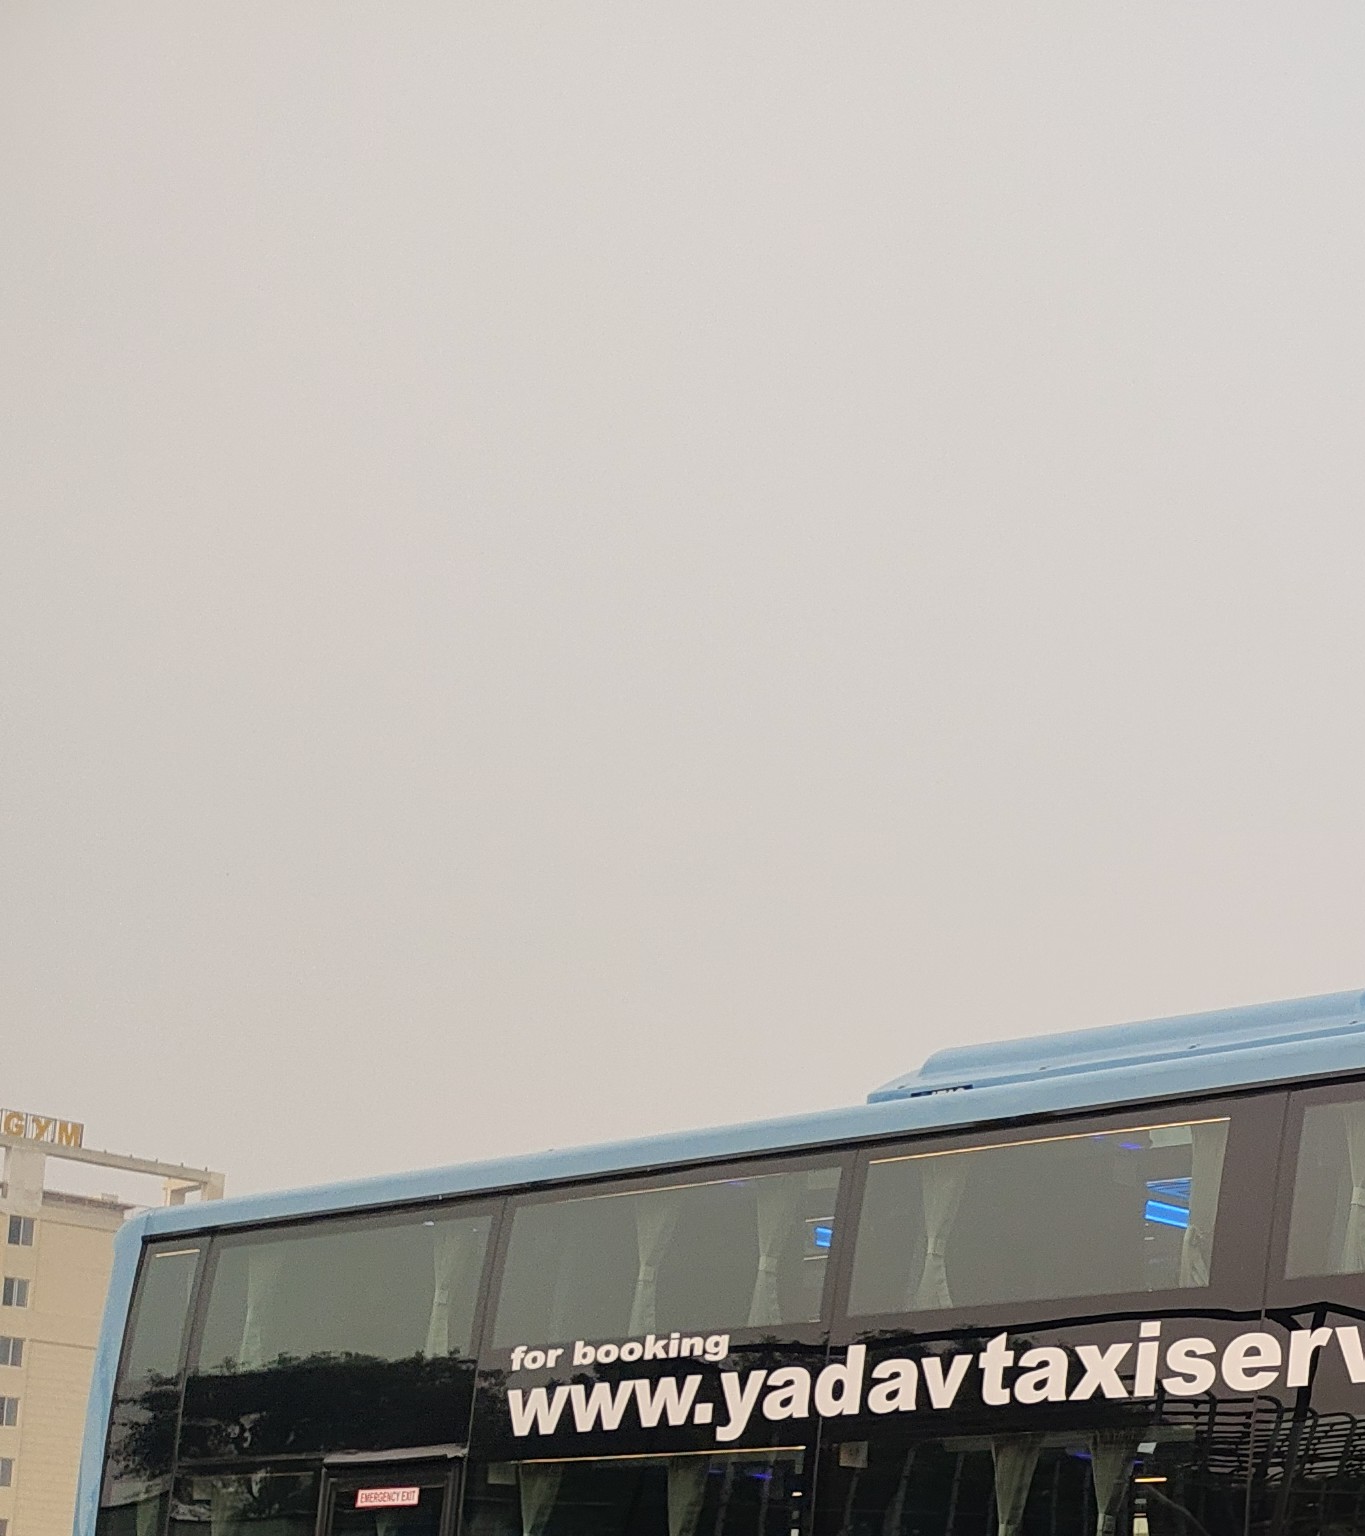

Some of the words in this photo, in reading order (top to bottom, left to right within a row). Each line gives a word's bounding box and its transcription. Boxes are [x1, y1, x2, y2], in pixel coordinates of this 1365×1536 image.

[4, 1111, 81, 1148] GYM
[511, 1345, 564, 1372] for
[572, 1331, 730, 1367] booking
[360, 1491, 400, 1503] EMERGENCY
[401, 1490, 416, 1501] EXIT
